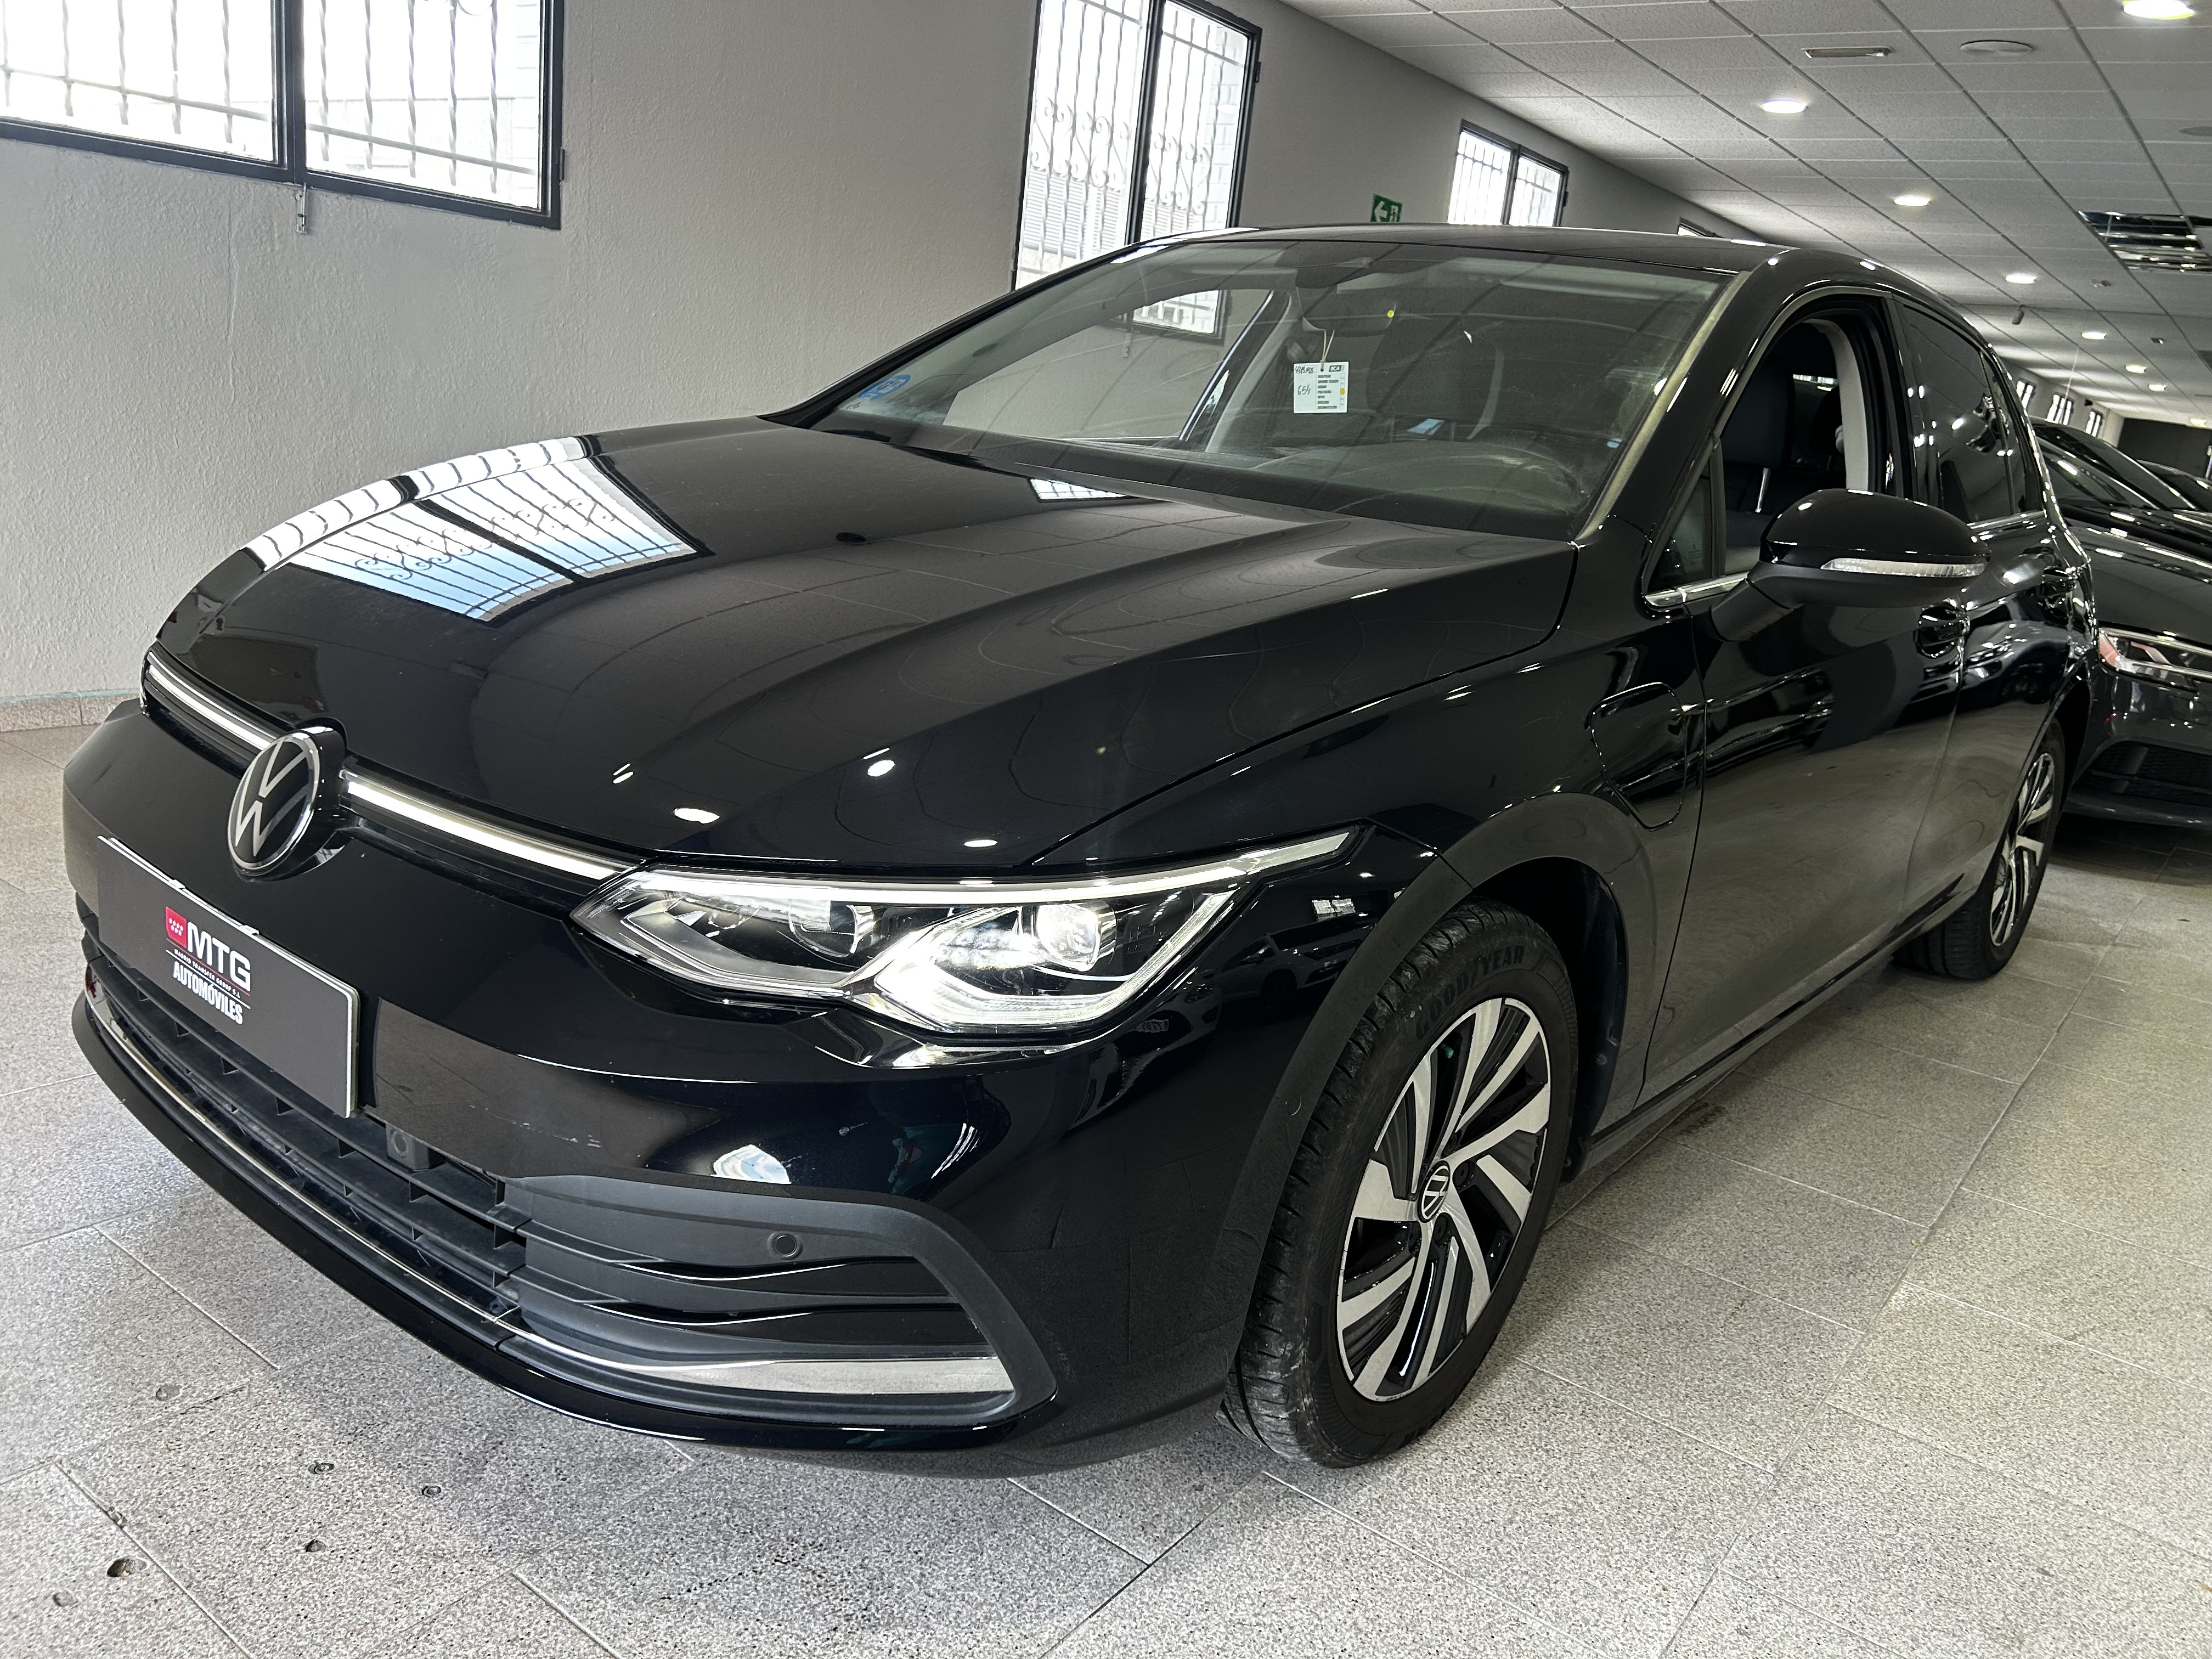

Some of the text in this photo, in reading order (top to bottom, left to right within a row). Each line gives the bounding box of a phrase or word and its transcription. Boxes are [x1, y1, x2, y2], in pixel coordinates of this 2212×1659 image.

[187, 922, 251, 992] MTG
[192, 961, 215, 980] TRANSFER
[216, 978, 232, 991] GROUP
[173, 961, 243, 1024] AUTOMÓVILES
